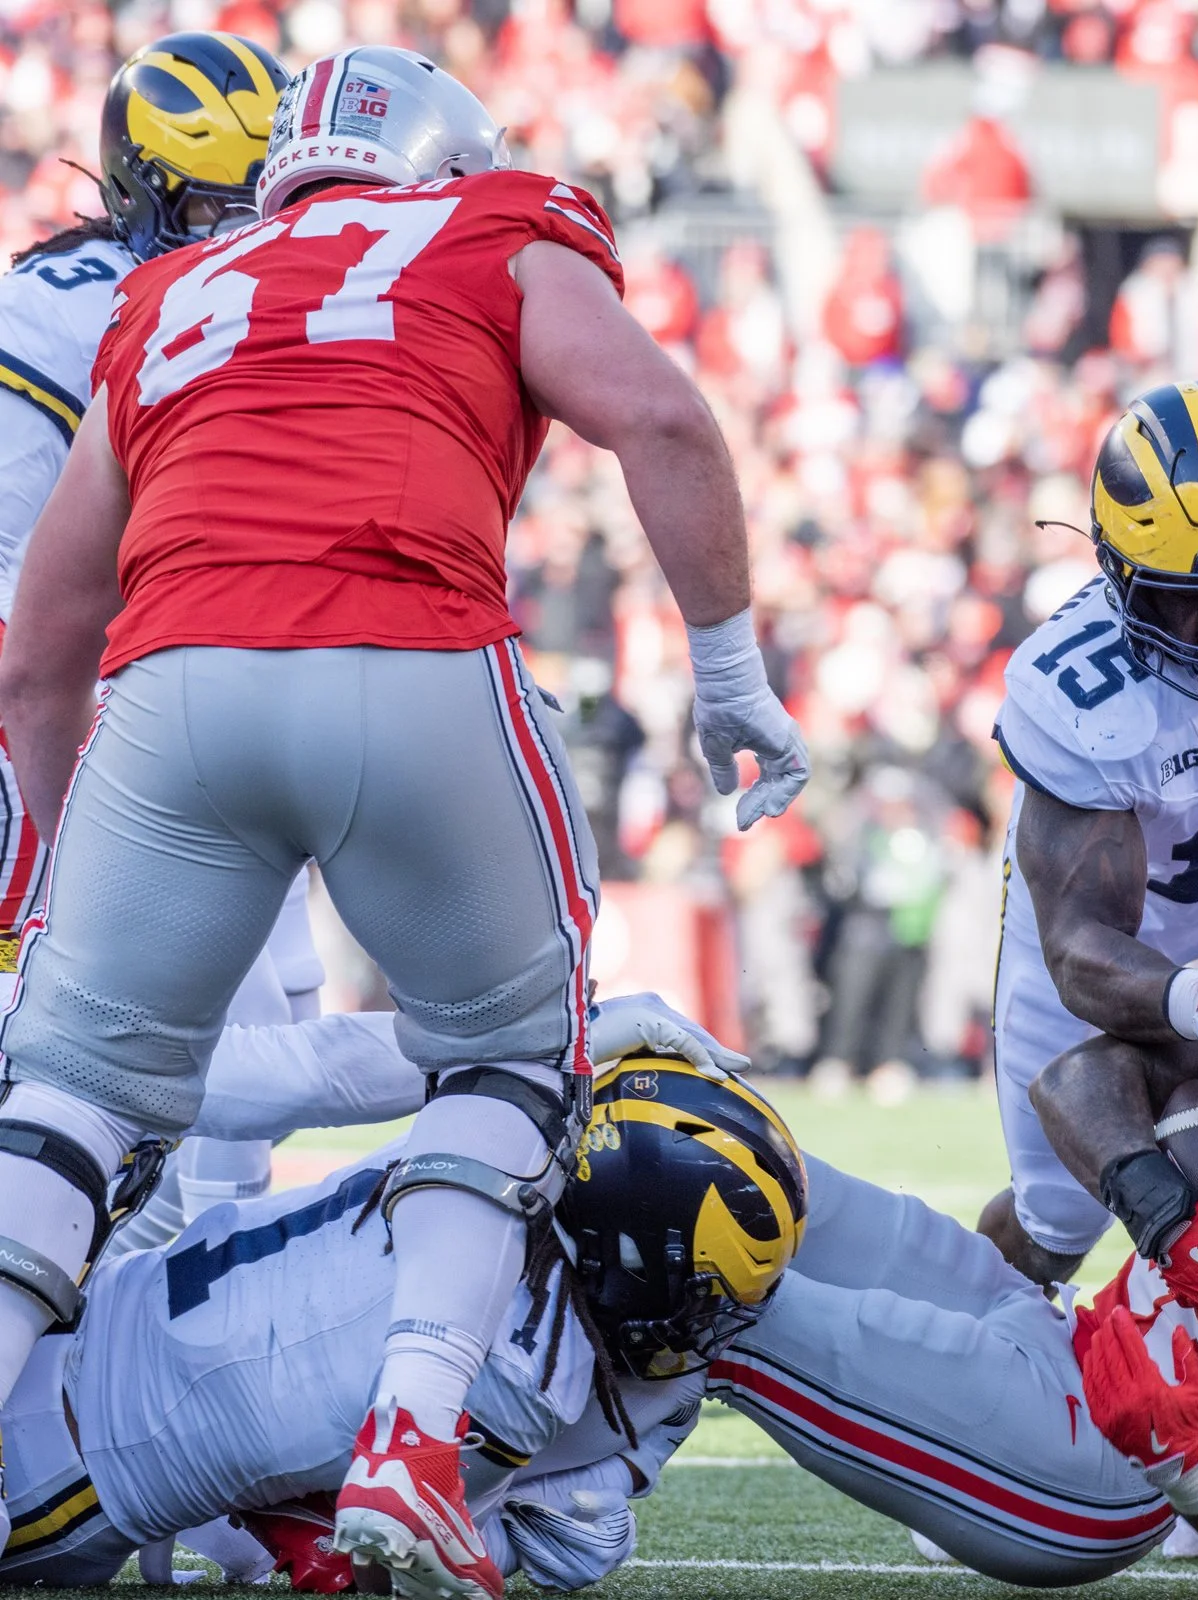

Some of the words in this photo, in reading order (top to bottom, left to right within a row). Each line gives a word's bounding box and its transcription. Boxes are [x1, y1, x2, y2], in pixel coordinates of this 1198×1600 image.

[345, 82, 364, 93] 67
[259, 145, 377, 190] BUCKEYES
[137, 197, 461, 406] 67
[1032, 619, 1152, 711] 15
[166, 1168, 385, 1321] 1
[416, 1500, 454, 1545] FORCE
